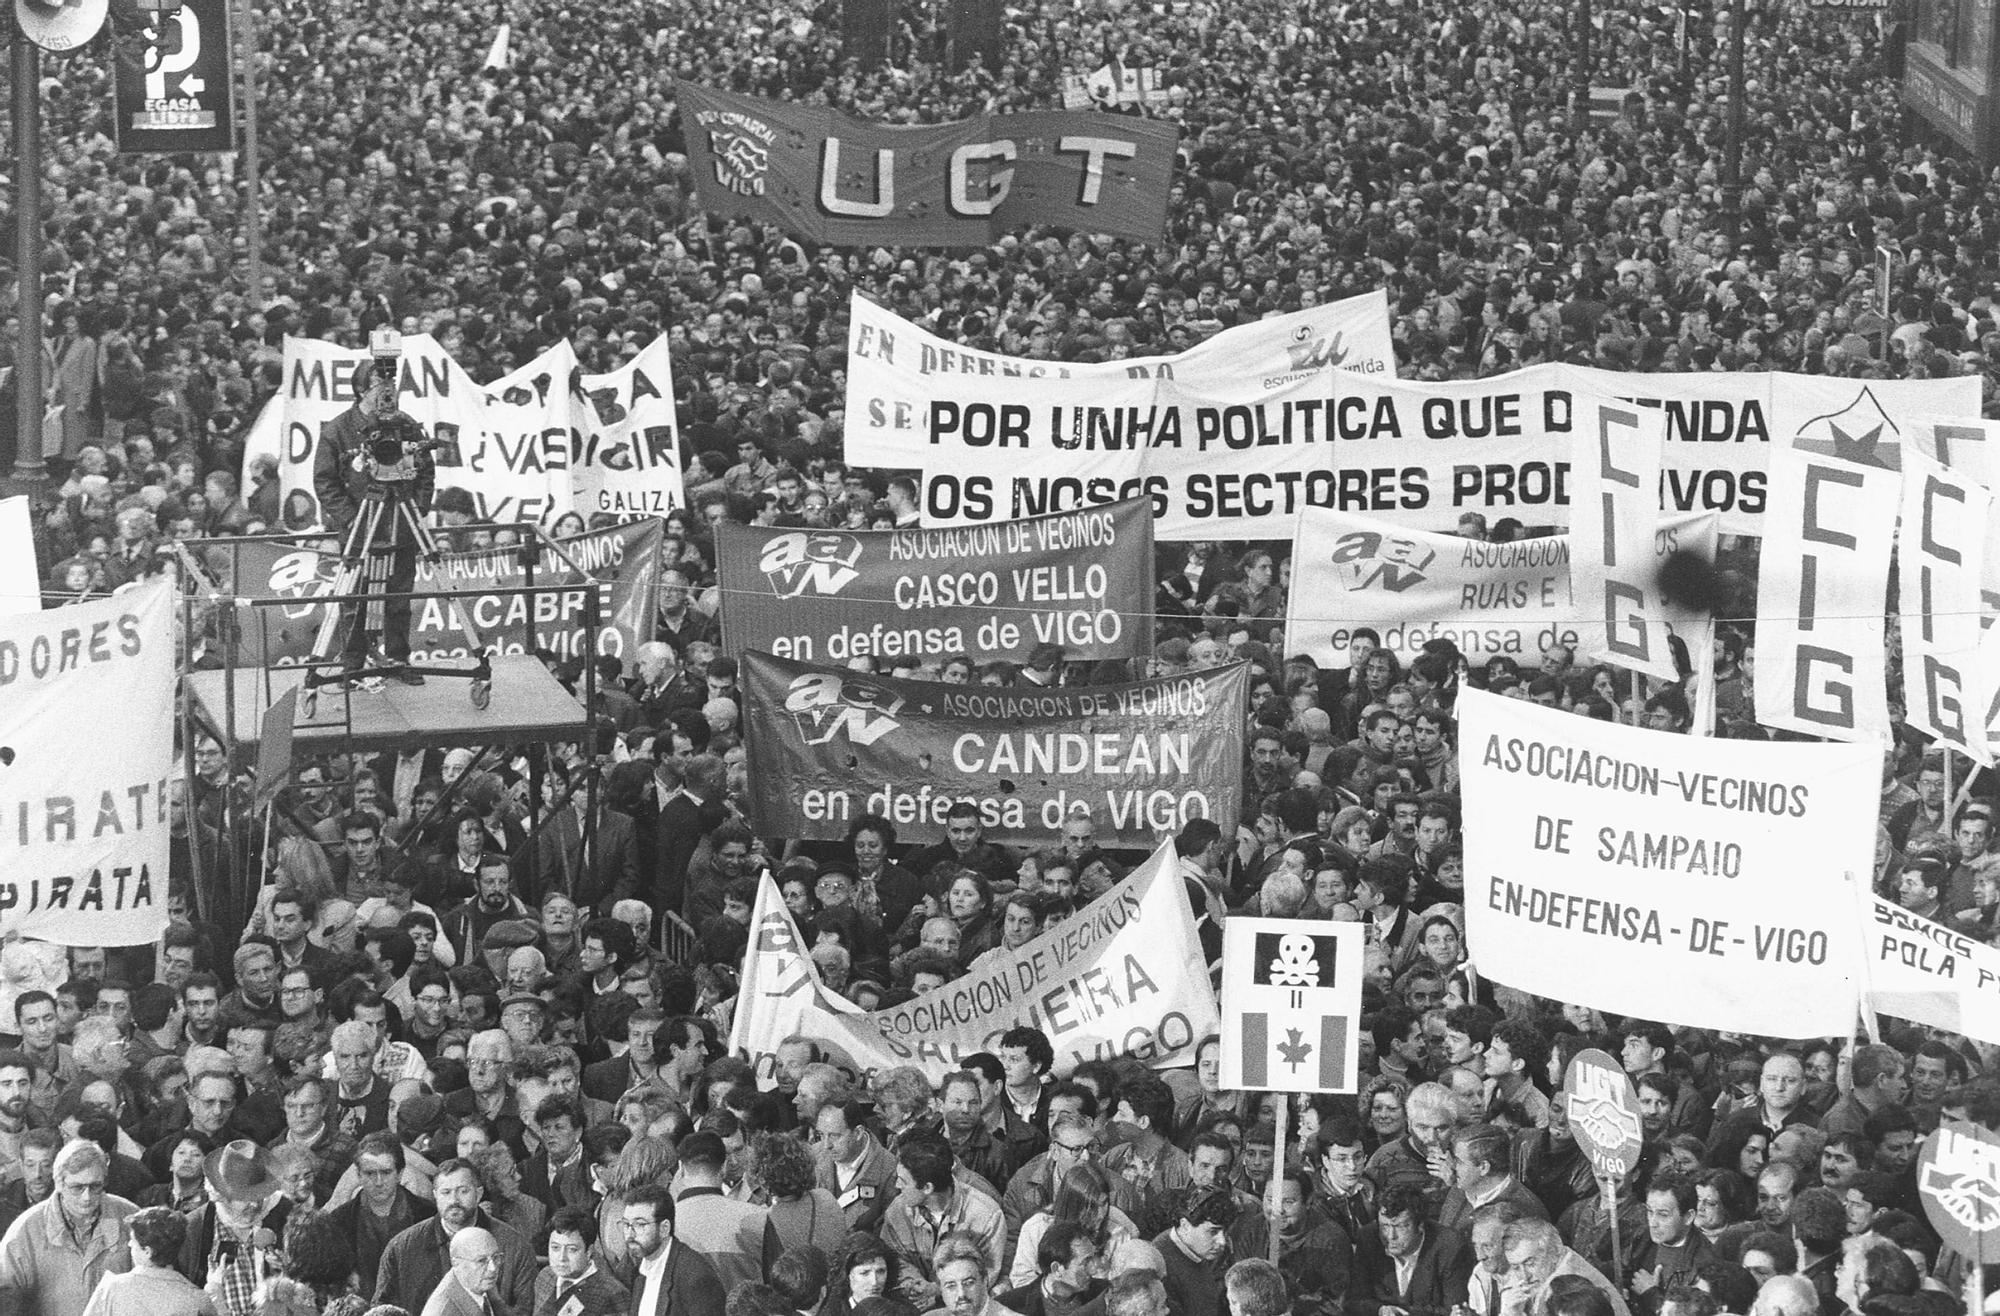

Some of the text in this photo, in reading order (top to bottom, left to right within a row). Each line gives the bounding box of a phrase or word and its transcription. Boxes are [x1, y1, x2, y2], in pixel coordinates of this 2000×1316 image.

[144, 99, 201, 112] EGASA
[716, 160, 765, 195] VIGO
[821, 136, 1137, 218] UGT
[854, 323, 895, 365] EN
[292, 355, 450, 402] MEAN
[868, 398, 927, 430] SE
[930, 390, 1770, 452] POR UNHA POLITICA QUE DNDA
[599, 489, 677, 512] GALIZA
[928, 474, 994, 520] OS
[1011, 475, 1169, 519] NOSOS
[1186, 466, 1430, 518] SECTORES
[889, 511, 1116, 561] ASOCIACION DE VECIÑOS
[1460, 538, 1570, 569] ASOCIACION
[1599, 405, 1650, 663] CIG
[894, 563, 1108, 611] CASCO VELLO
[1459, 576, 1556, 610] RUAS E
[1795, 463, 1865, 729] CIG
[1921, 474, 1968, 748] CIG
[772, 608, 1122, 662] en defensa de VIGO
[1537, 621, 1579, 654] de
[943, 692, 1073, 719] ASOCIACION
[1078, 693, 1110, 717] DE
[952, 732, 1190, 775] CANDEAN
[803, 788, 849, 821] en
[866, 783, 1026, 830] defesa
[1107, 788, 1210, 831] VIGO
[1535, 815, 1742, 879] DE SAMPAIO
[1880, 934, 2000, 994] POLA P
[877, 970, 1013, 1035] SOCIACION
[1017, 951, 1049, 995] DE
[1576, 1060, 1627, 1111] UGT
[1592, 1148, 1626, 1175] VIGO
